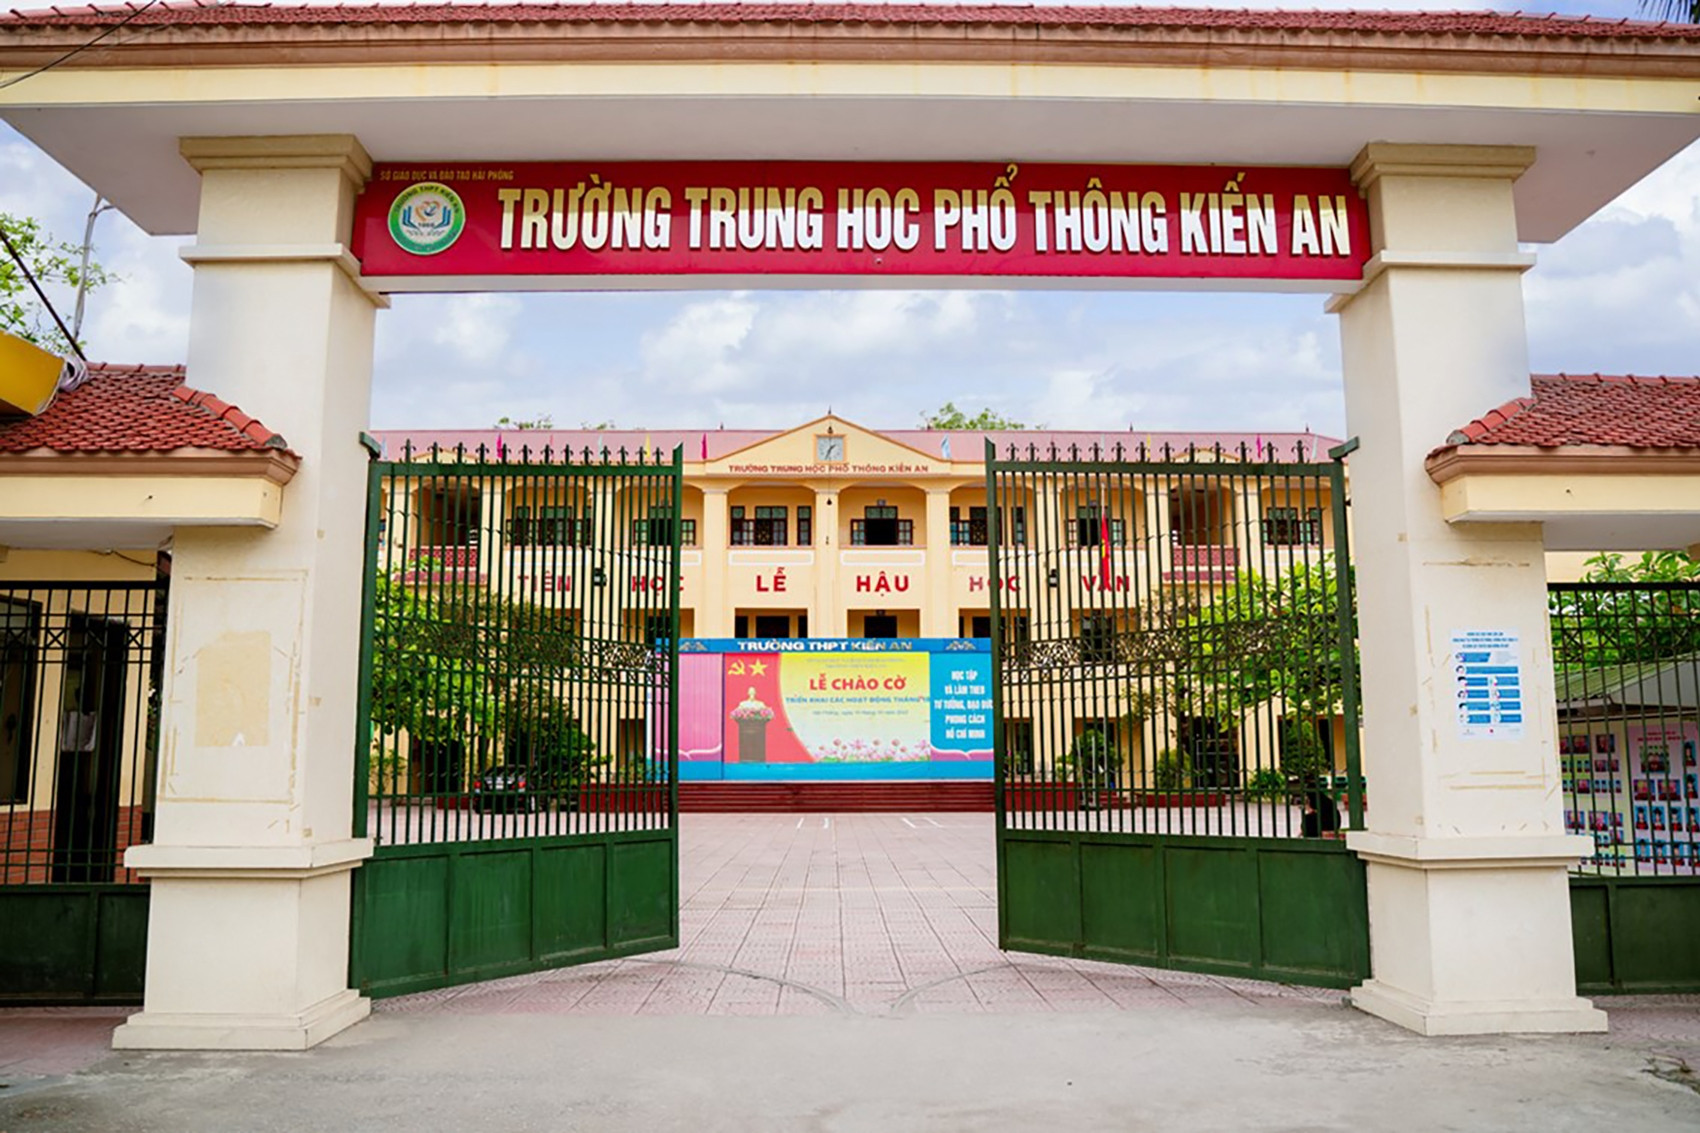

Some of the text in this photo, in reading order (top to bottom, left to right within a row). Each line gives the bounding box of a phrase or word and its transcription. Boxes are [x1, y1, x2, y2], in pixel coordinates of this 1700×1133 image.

[498, 174, 672, 250] TRƯỜNG
[685, 186, 824, 250] TRUNG
[934, 164, 1017, 252] PHỔ
[1028, 178, 1168, 254] THÔNG
[1180, 172, 1277, 255] KIẾN
[1292, 194, 1351, 256] AN
[729, 463, 768, 473] TRƯỜNG
[771, 465, 803, 473] TRUNG
[805, 465, 825, 474] HỌC
[852, 463, 886, 473] THÔNG
[914, 465, 928, 473] AN
[755, 566, 787, 592] LỄ
[856, 570, 909, 597] HẬU
[738, 638, 912, 651] TRƯỜNG THPT KIẾN AN
[809, 672, 907, 690] LỄ CHÀO CỜ
